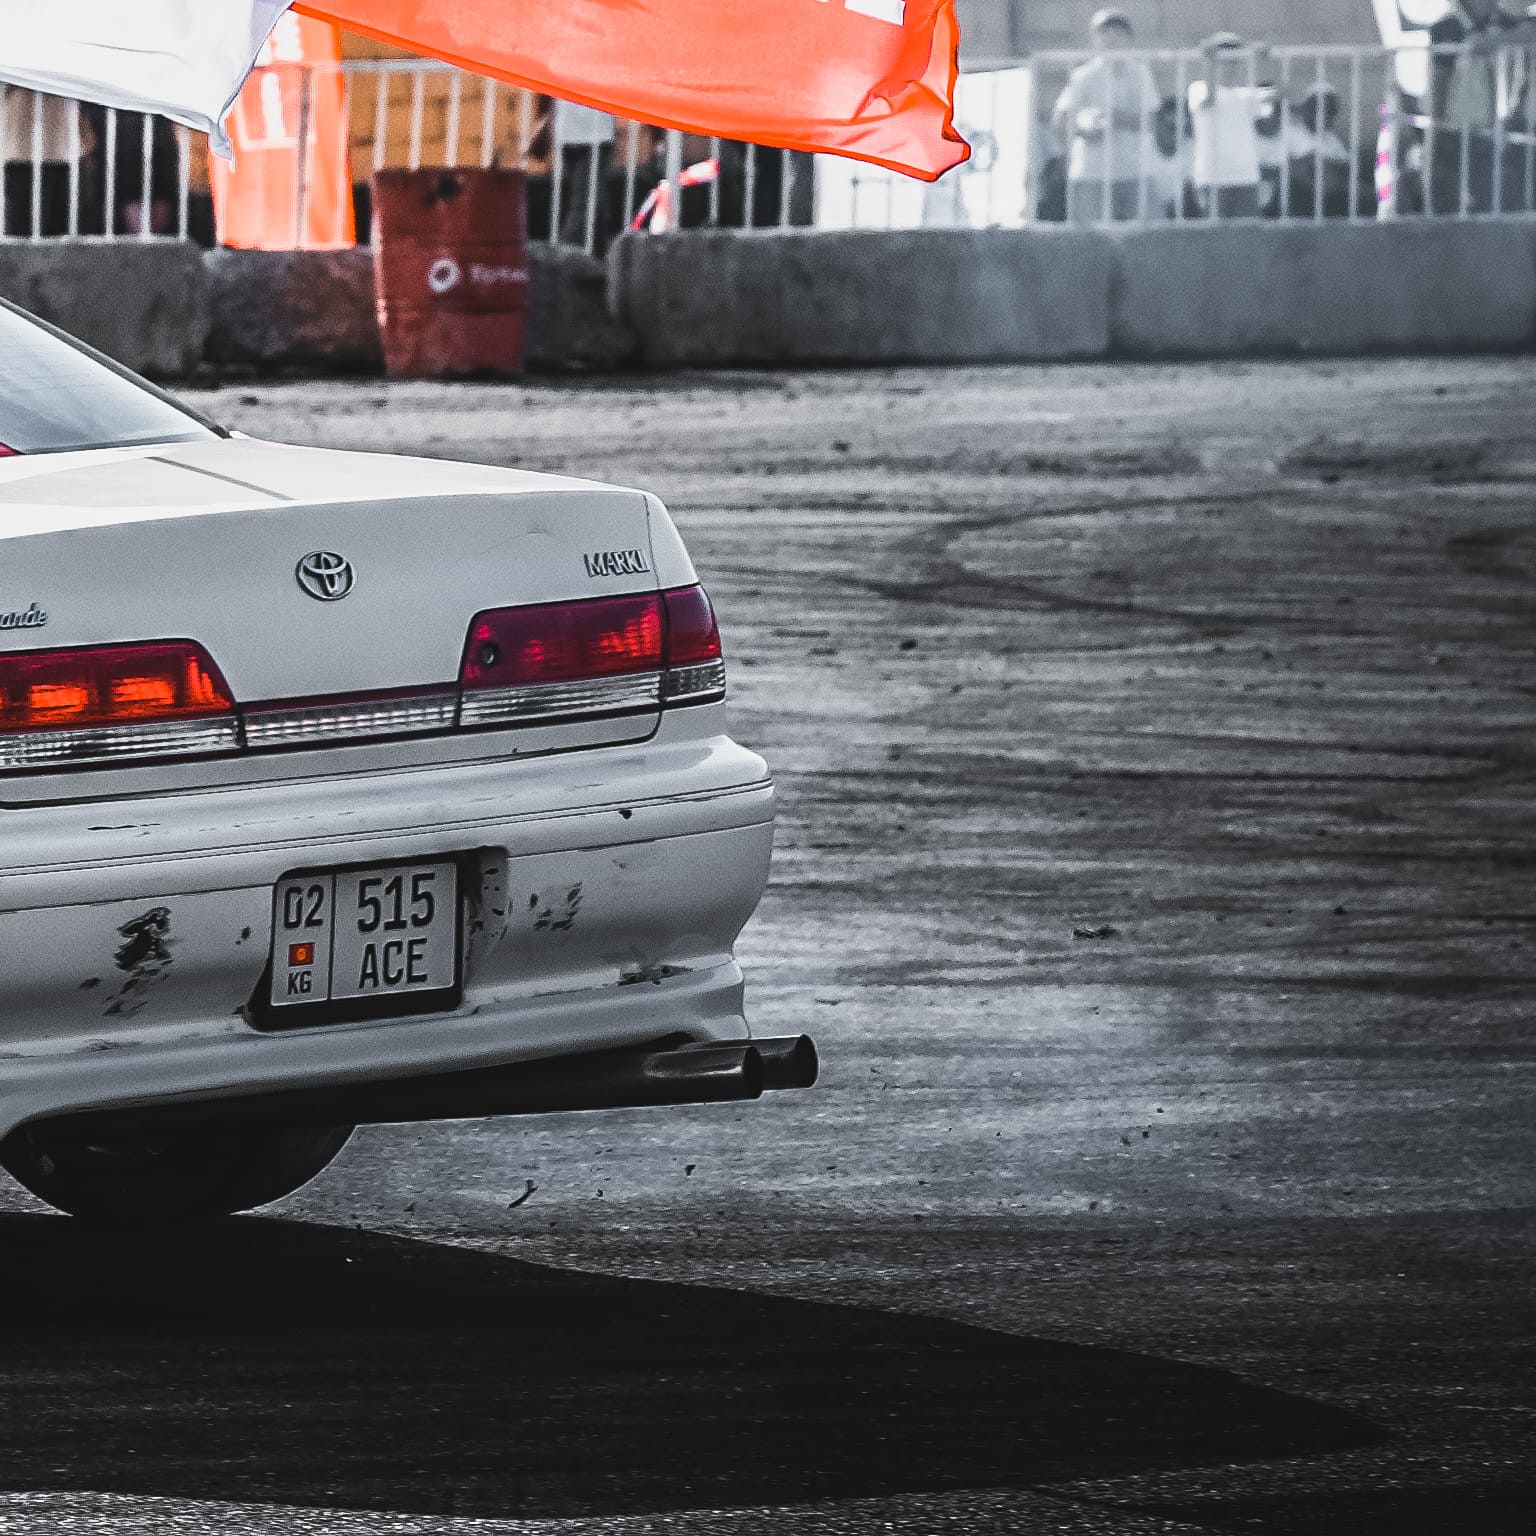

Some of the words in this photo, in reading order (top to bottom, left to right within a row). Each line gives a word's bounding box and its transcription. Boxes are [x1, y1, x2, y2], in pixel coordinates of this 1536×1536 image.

[283, 884, 325, 929] 02
[357, 872, 436, 933] 515
[287, 970, 312, 995] KG
[358, 937, 428, 989] ACE
